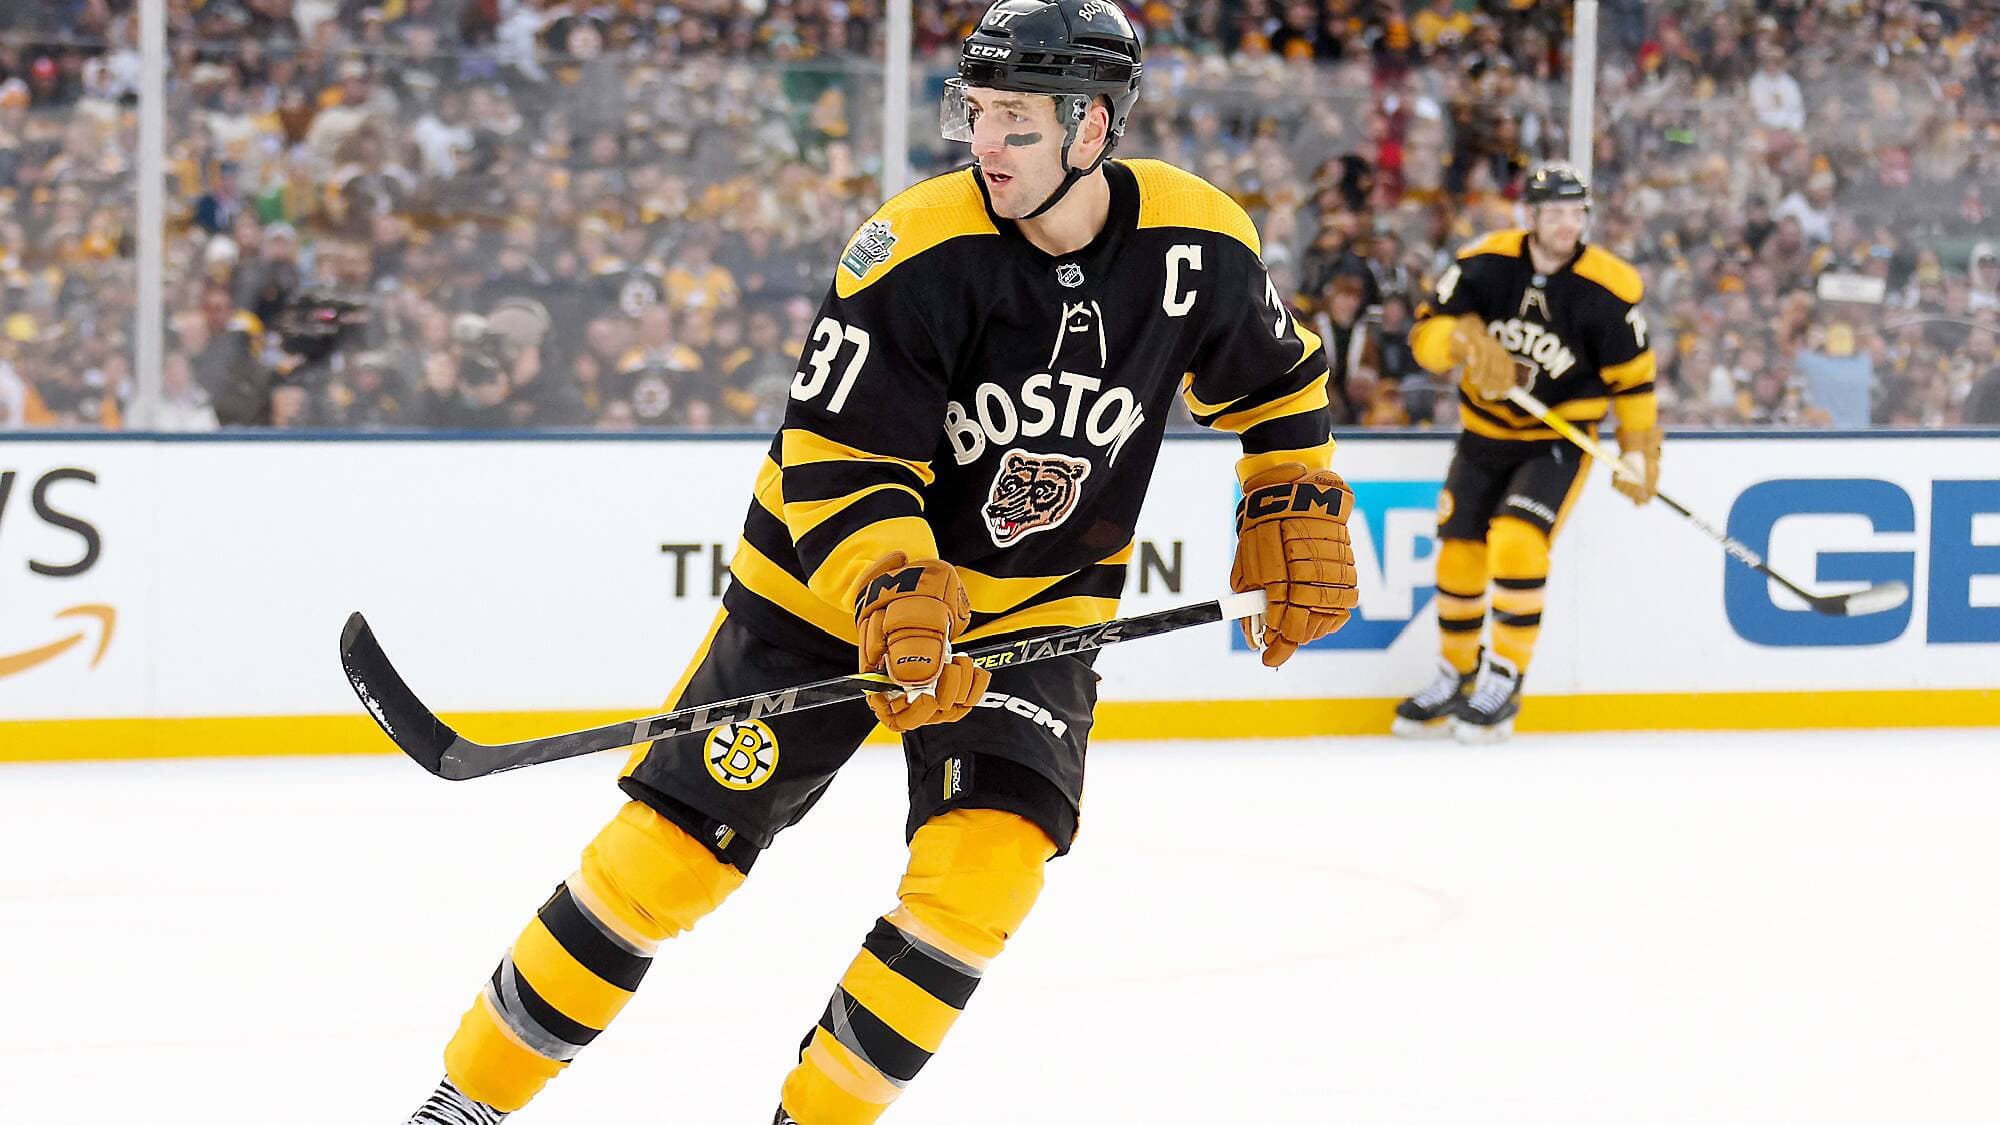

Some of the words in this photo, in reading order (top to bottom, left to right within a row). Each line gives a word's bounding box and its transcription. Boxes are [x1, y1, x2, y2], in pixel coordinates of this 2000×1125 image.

[968, 44, 1013, 61] CCM
[1162, 244, 1203, 318] C
[790, 317, 871, 414] 37
[1487, 317, 1577, 380] OSTON
[943, 370, 1146, 469] BOSTON
[896, 655, 932, 665] CCM
[1014, 624, 1123, 662] TACKS
[632, 687, 799, 744] CCM
[976, 691, 1069, 740] CCM
[720, 727, 762, 778] B
